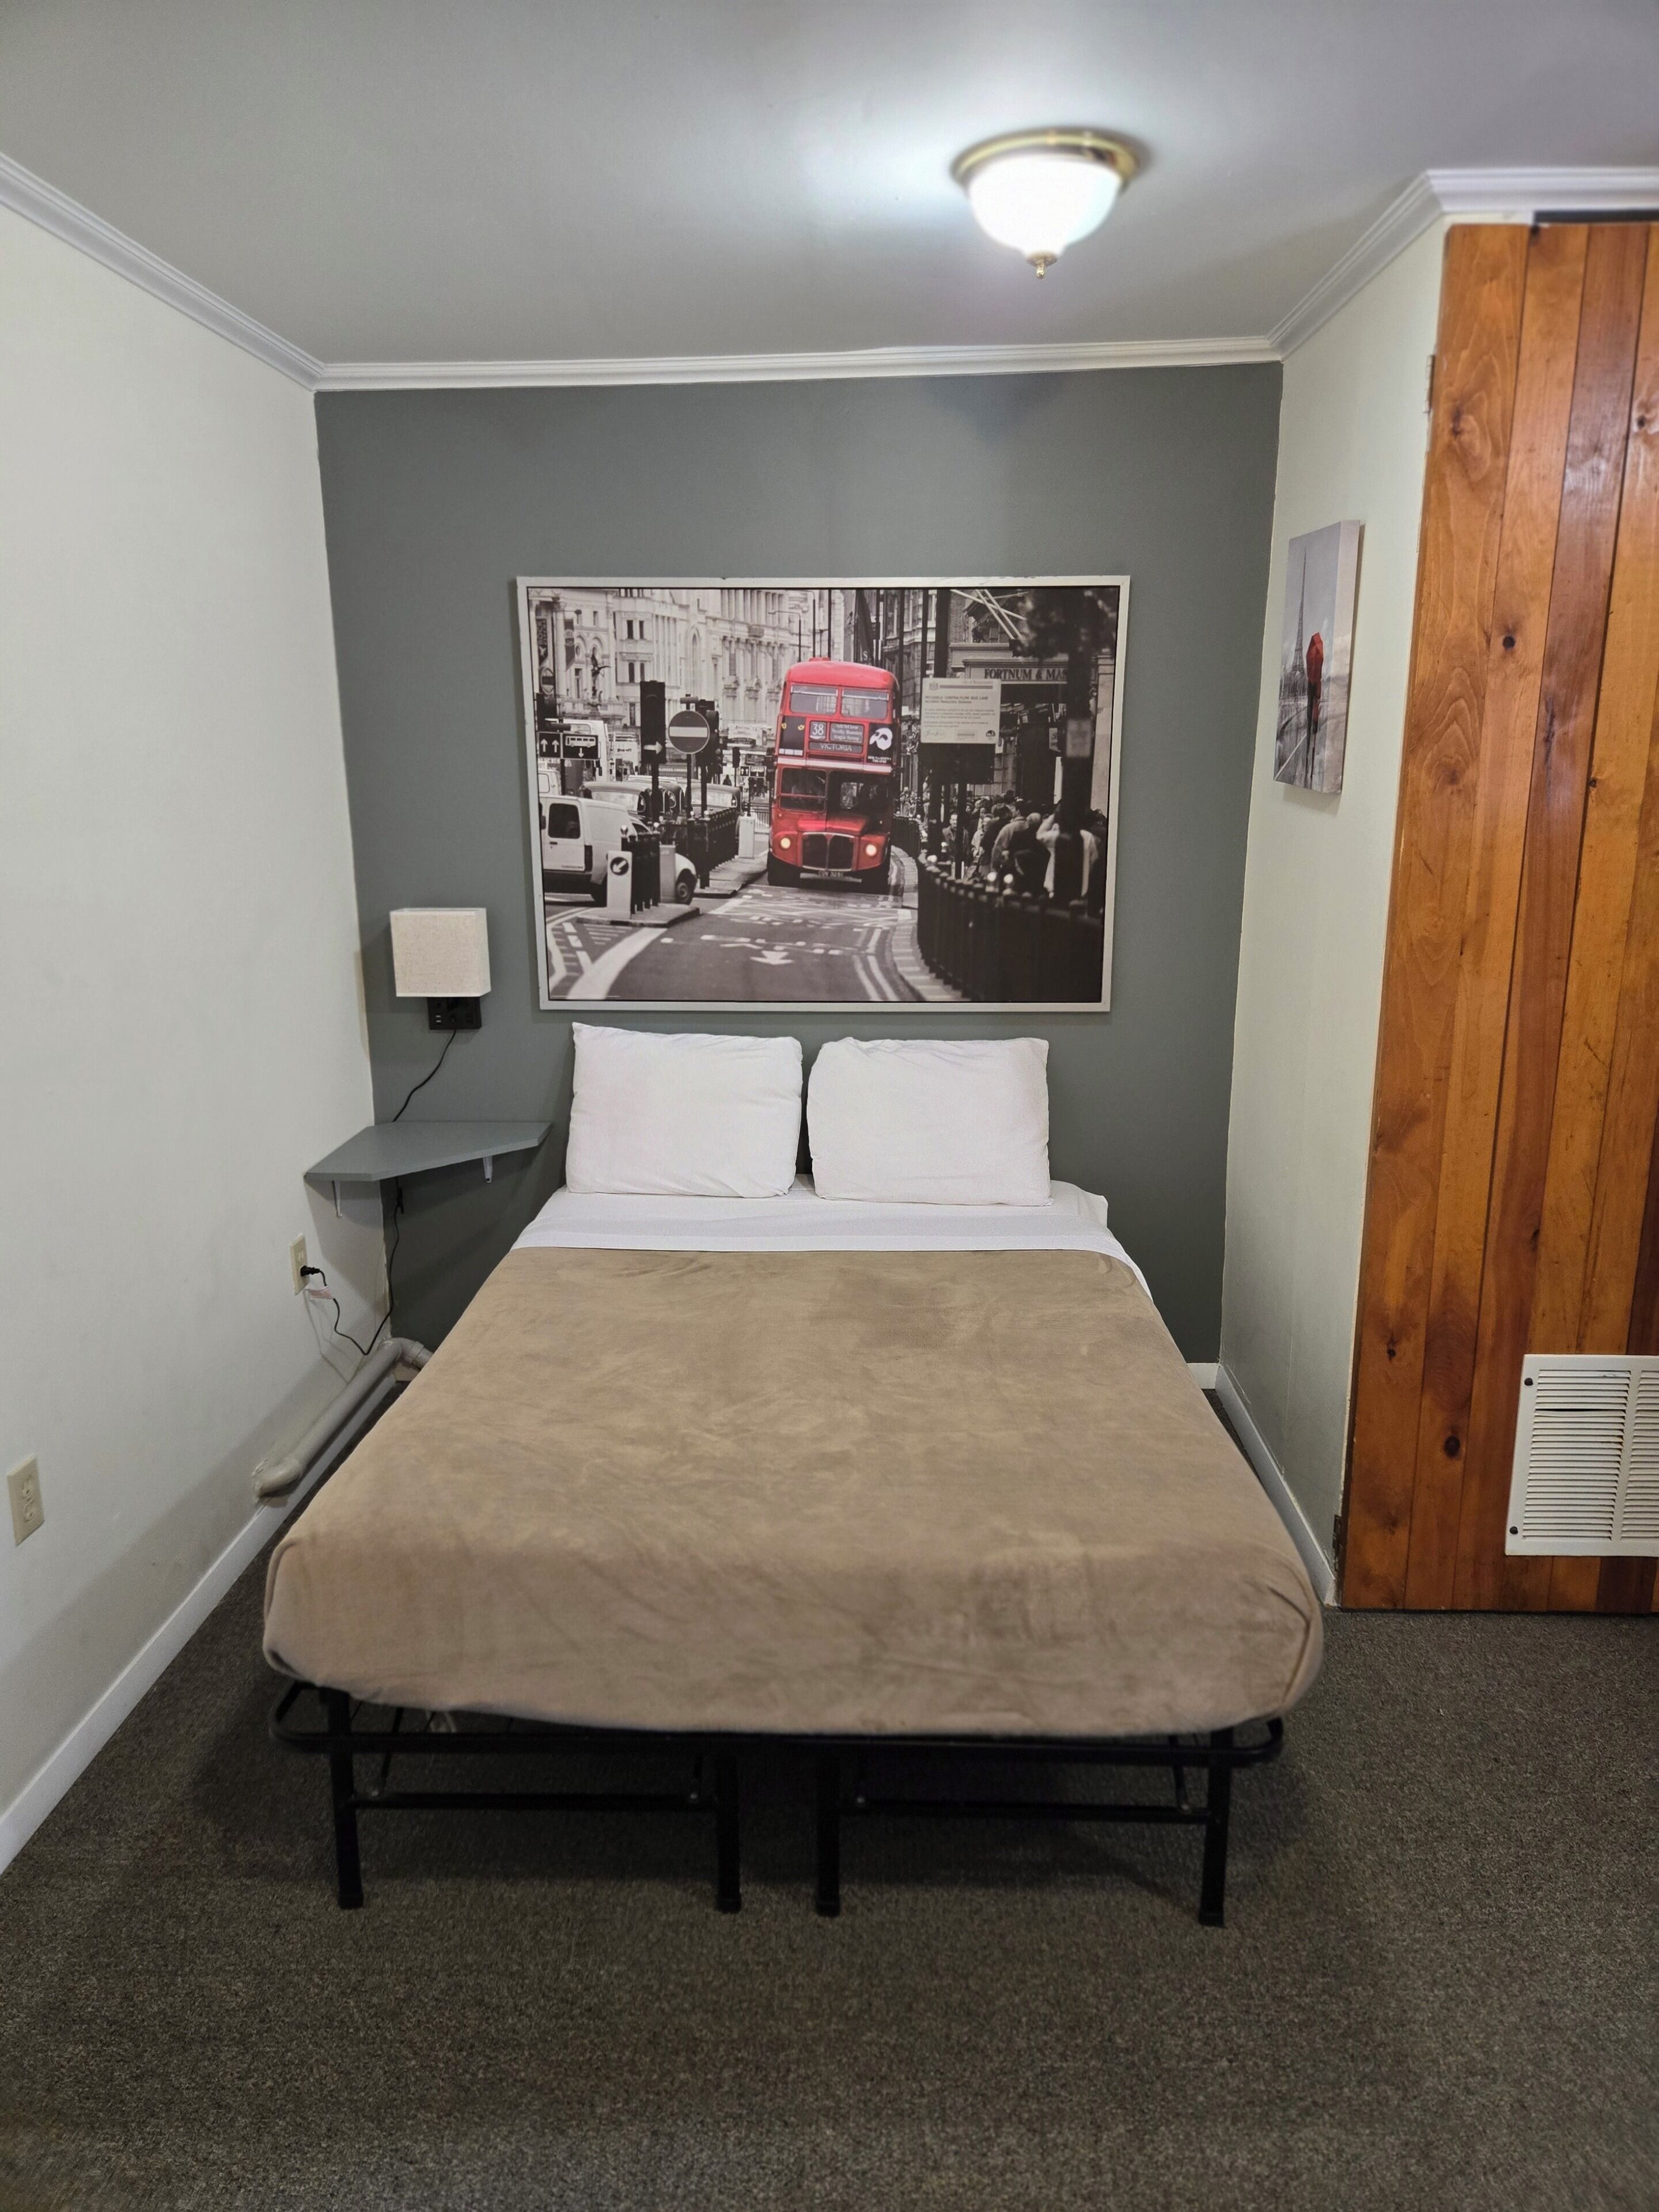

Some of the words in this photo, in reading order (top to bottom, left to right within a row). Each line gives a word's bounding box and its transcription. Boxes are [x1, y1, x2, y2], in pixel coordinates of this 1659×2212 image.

[984, 668, 1032, 680] FORTNUM
[1035, 669, 1043, 680] &
[812, 724, 824, 735] 38
[820, 743, 852, 752] VICTORIA
